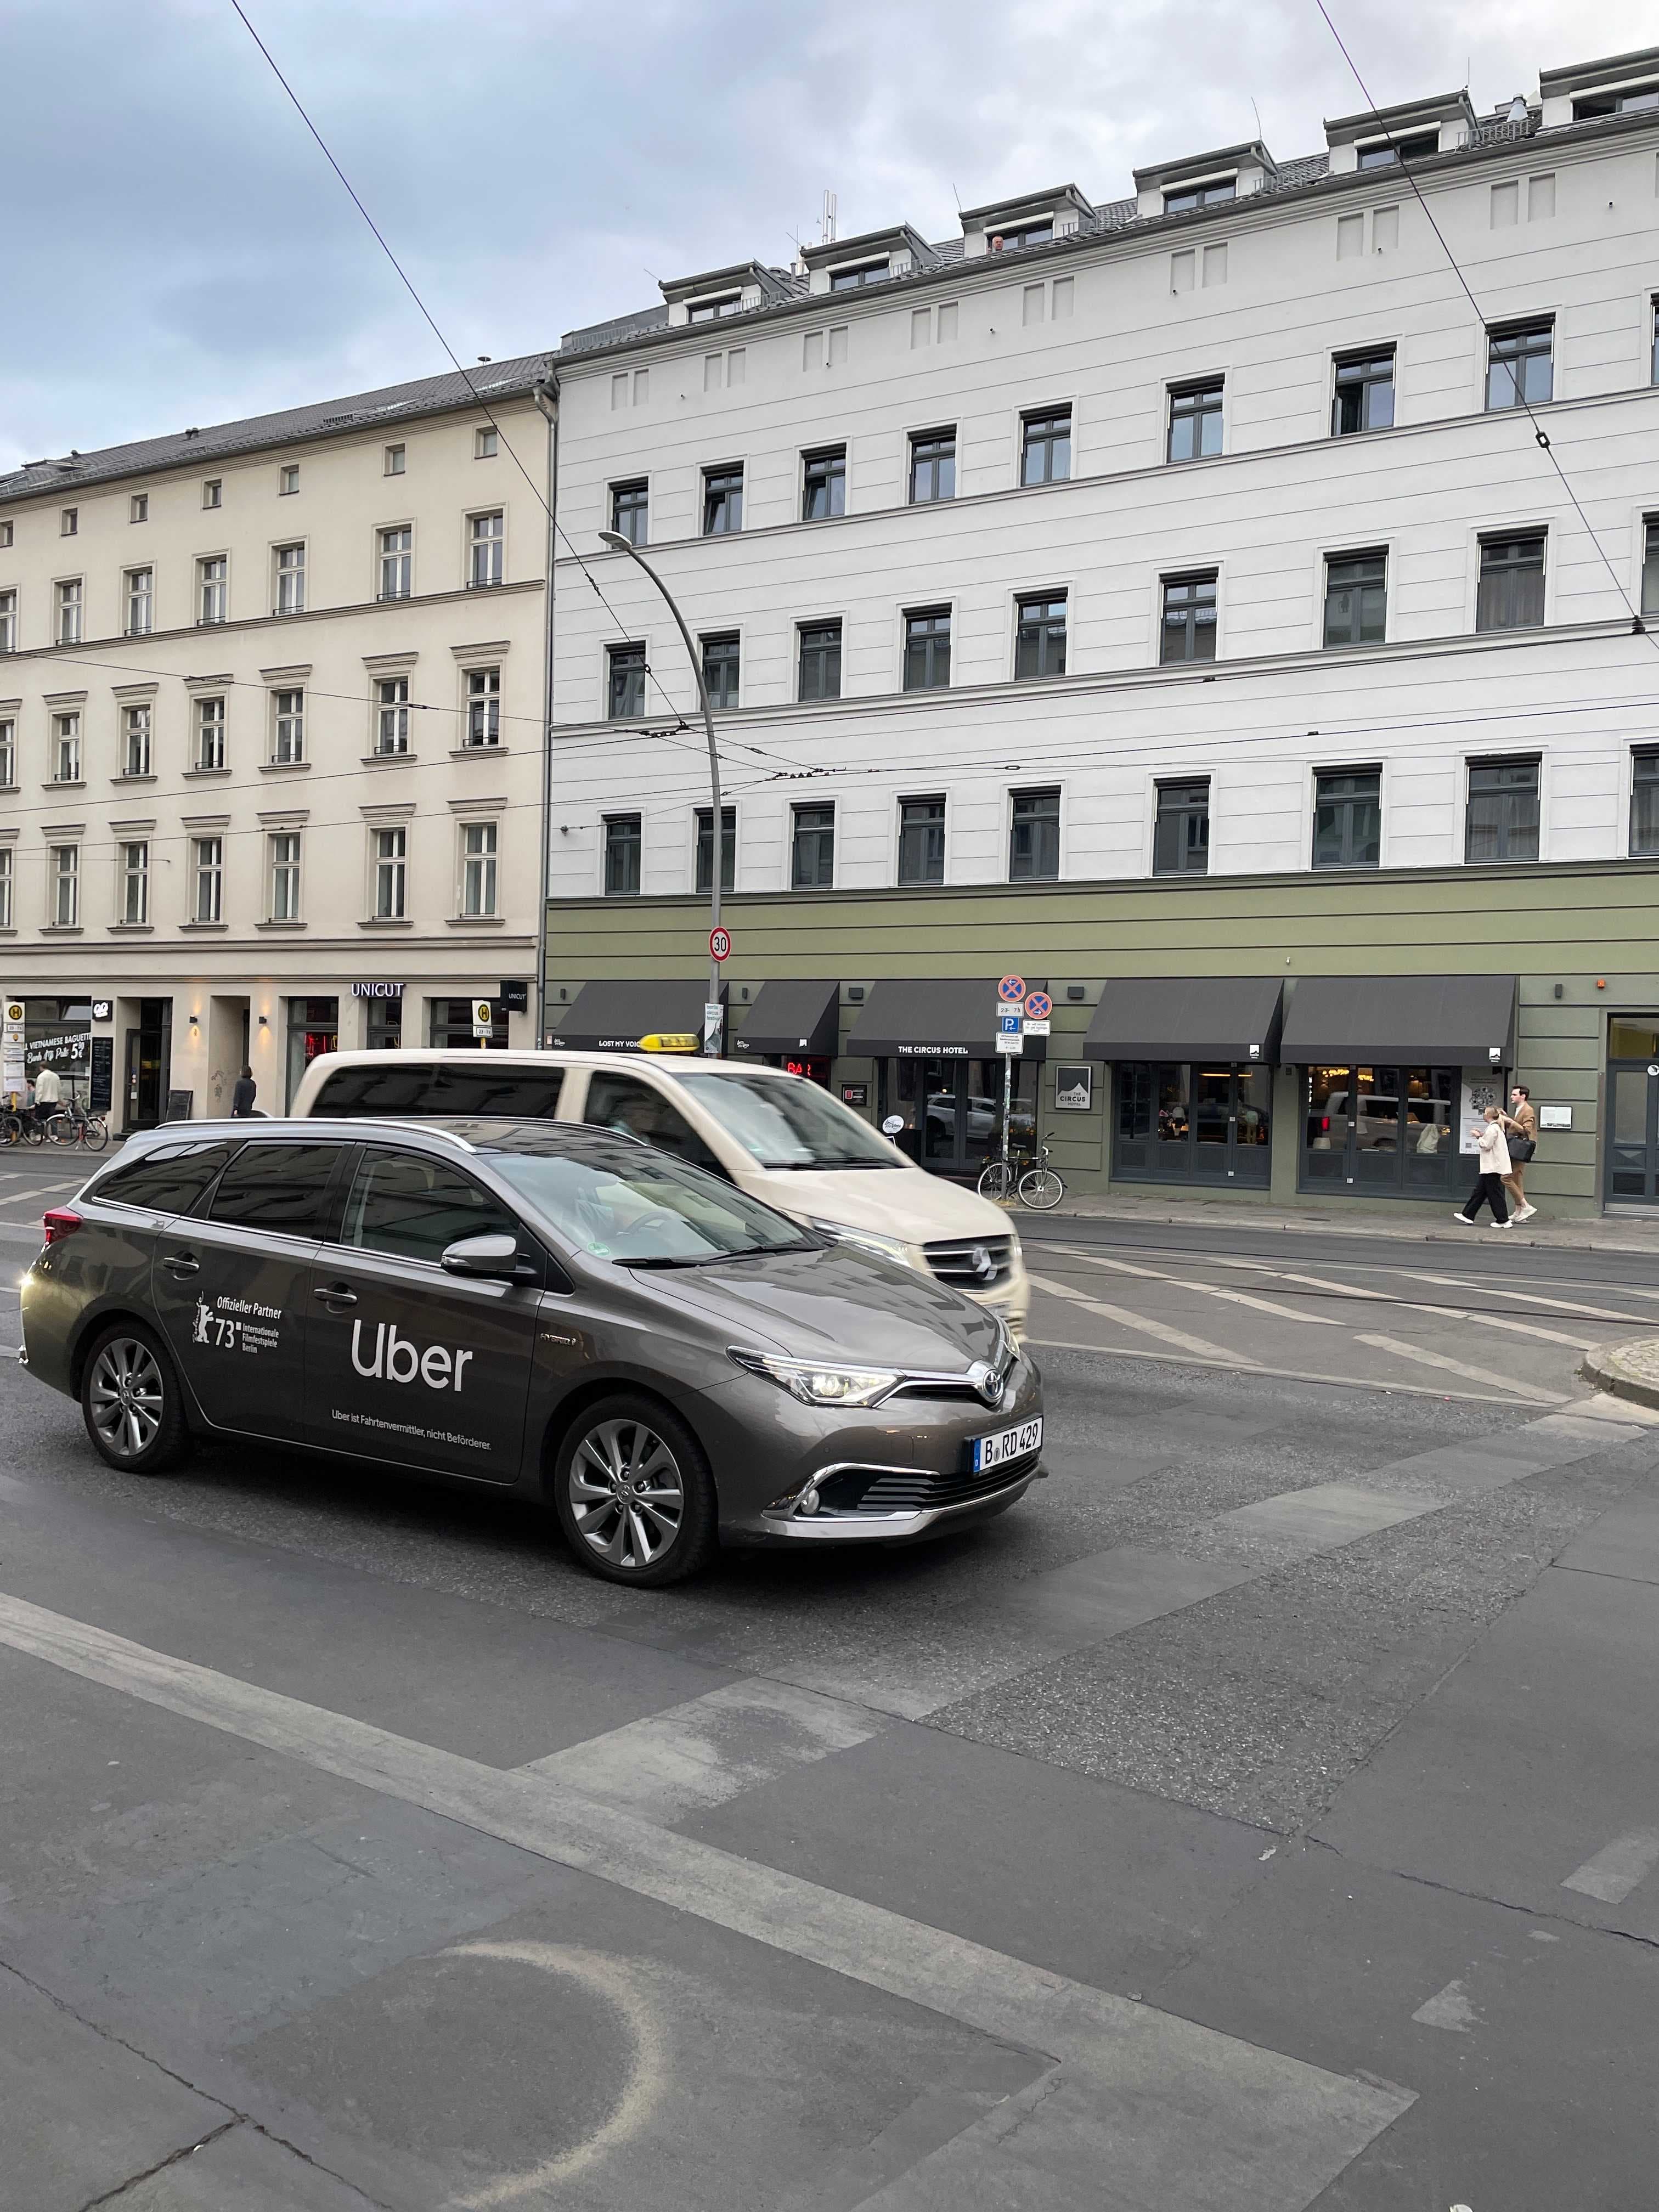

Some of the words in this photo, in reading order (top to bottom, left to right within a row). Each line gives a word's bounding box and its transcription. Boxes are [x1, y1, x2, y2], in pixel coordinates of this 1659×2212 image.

[714, 936, 726, 952] 30
[351, 983, 404, 997] UNICUT
[1005, 1018, 1014, 1030] P
[29, 1036, 63, 1049] VIETNAMESE
[217, 1296, 252, 1314] Offizieller
[253, 1302, 282, 1319] Partner
[216, 1318, 235, 1348] 73
[242, 1323, 279, 1338] Internationale
[242, 1333, 278, 1348] Filmfestspiele
[242, 1342, 258, 1353] Berlin
[352, 1319, 473, 1392] Uber
[332, 1409, 350, 1421] Uber
[351, 1413, 360, 1424] ist
[360, 1415, 426, 1438] Fahrtenvermittler,
[426, 1429, 446, 1441] nicht
[447, 1432, 492, 1451] Beförderer.
[985, 1440, 992, 1464] B
[1002, 1431, 1017, 1459] RD
[1019, 1423, 1038, 1451] 429
